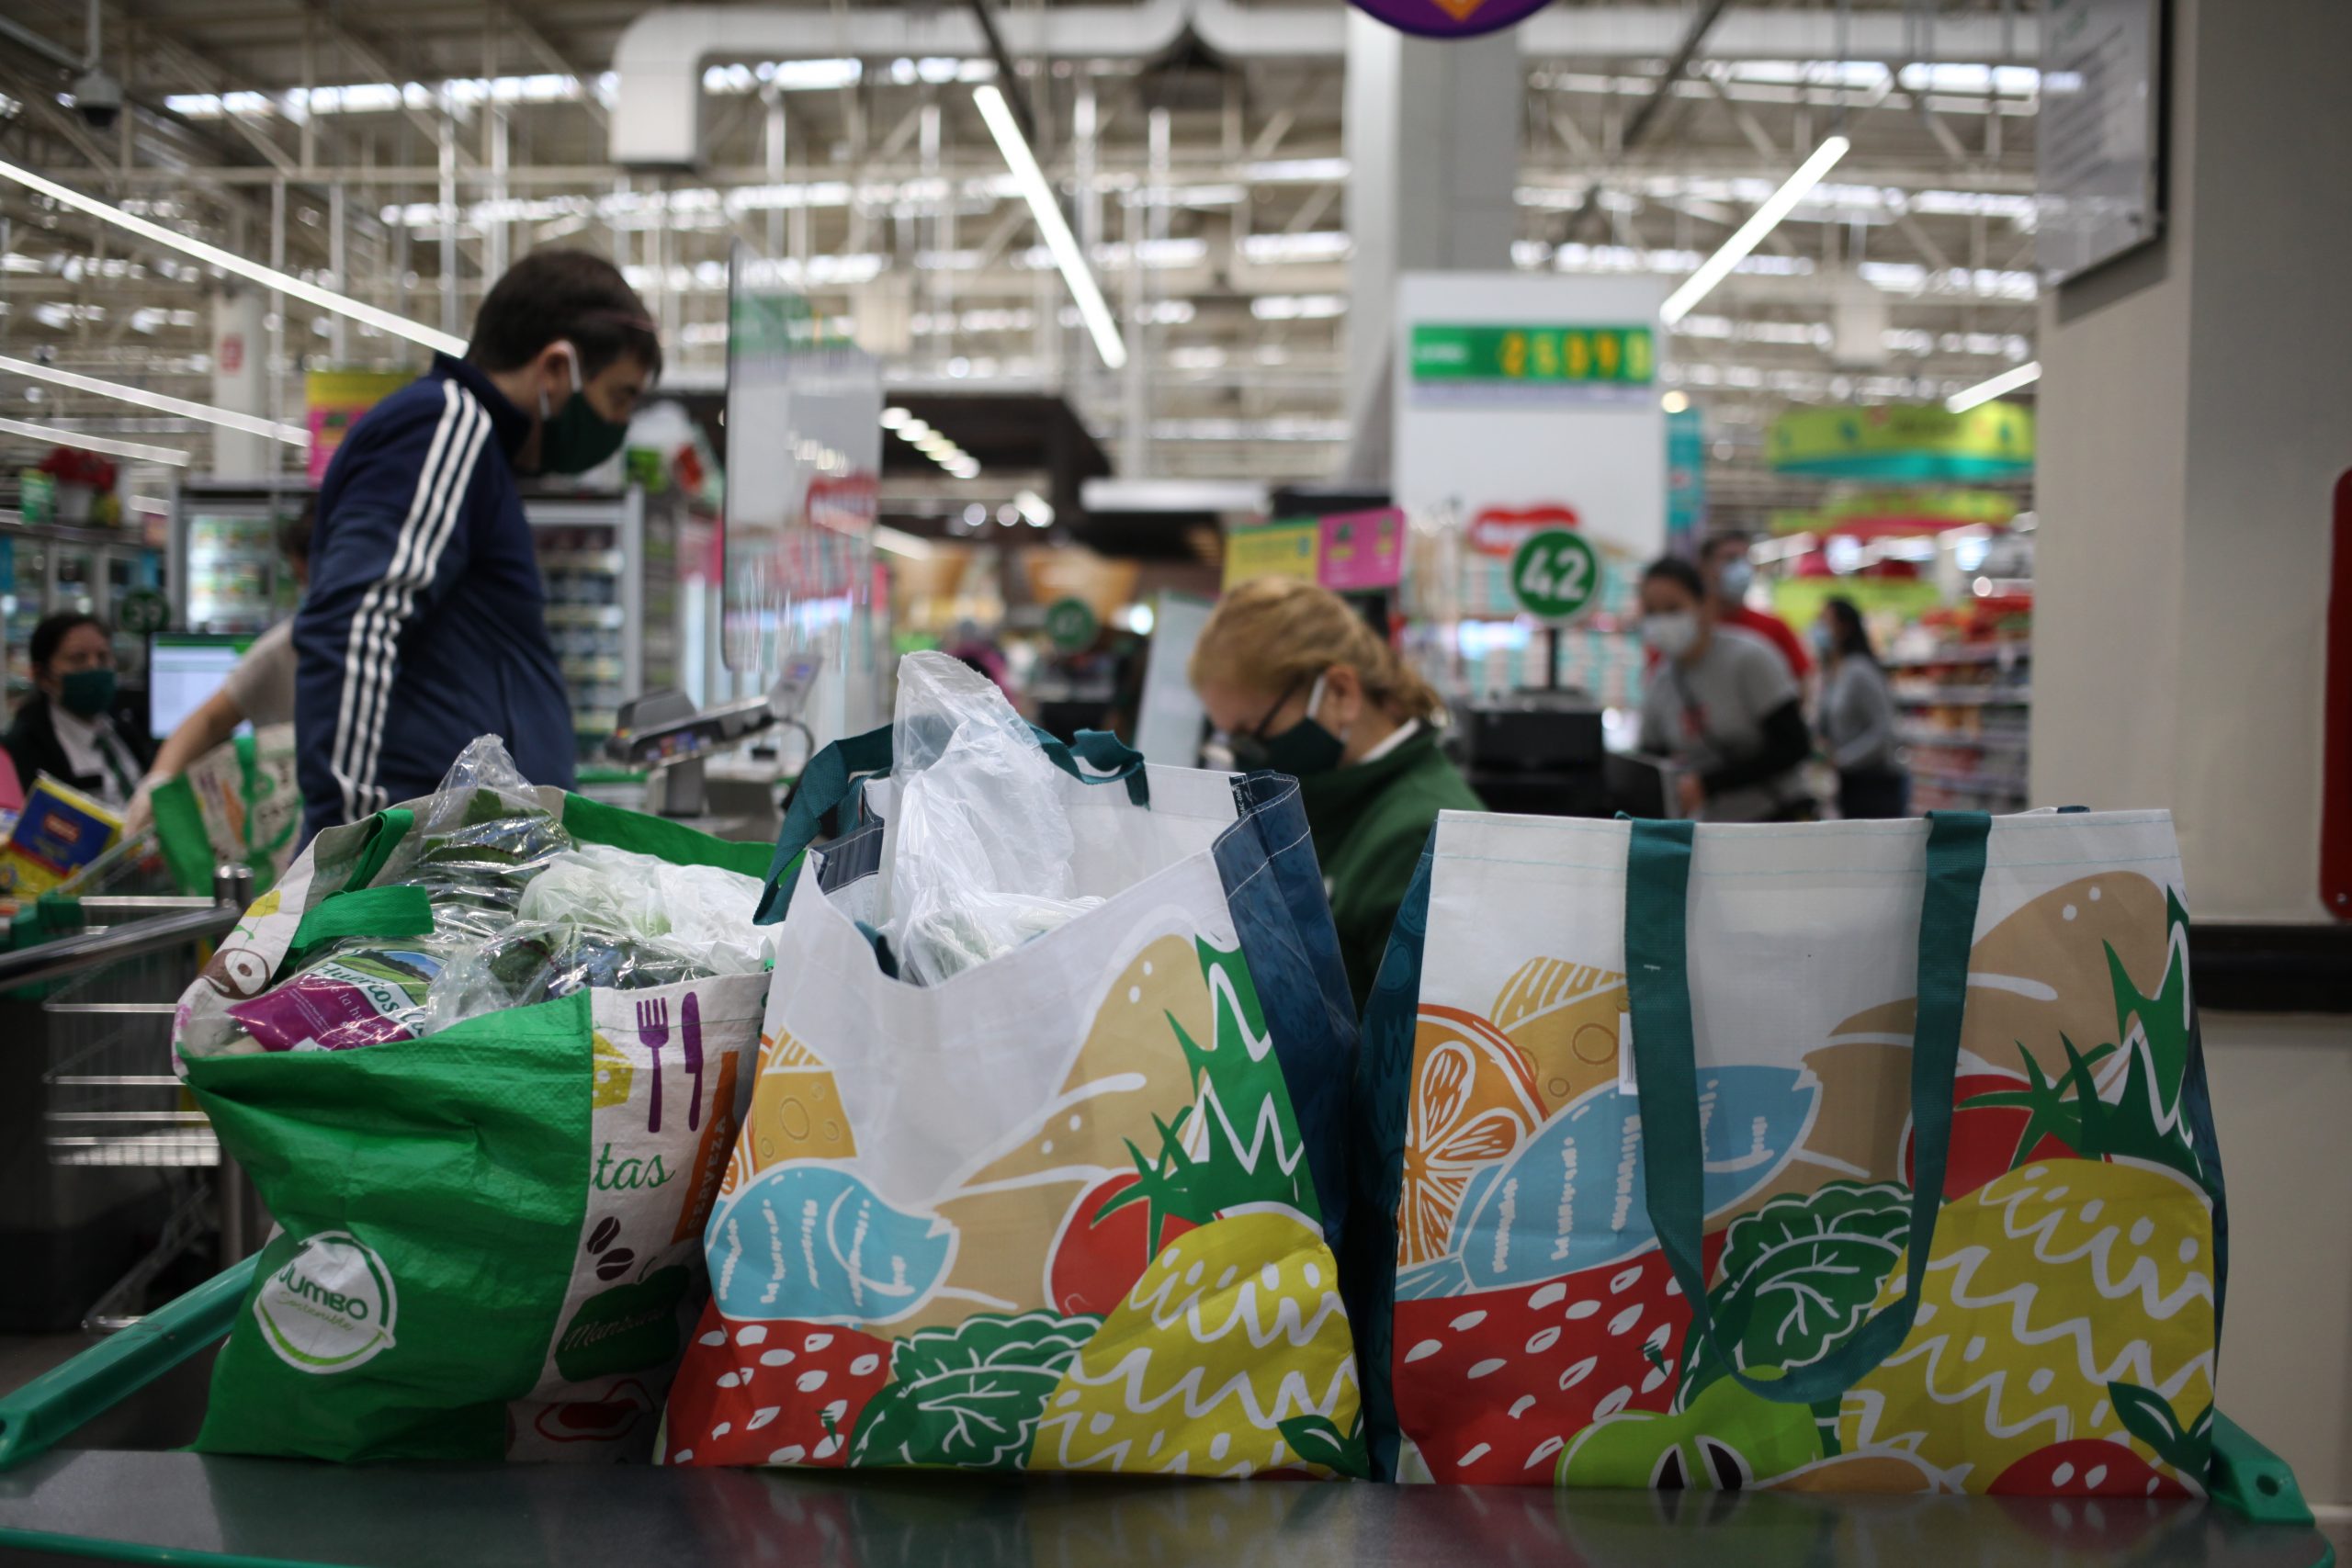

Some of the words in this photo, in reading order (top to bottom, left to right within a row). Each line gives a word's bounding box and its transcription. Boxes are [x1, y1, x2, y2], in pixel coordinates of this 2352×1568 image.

[1520, 547, 1587, 600] 42
[337, 992, 353, 1007] la
[688, 1115, 728, 1231] CERVEZA
